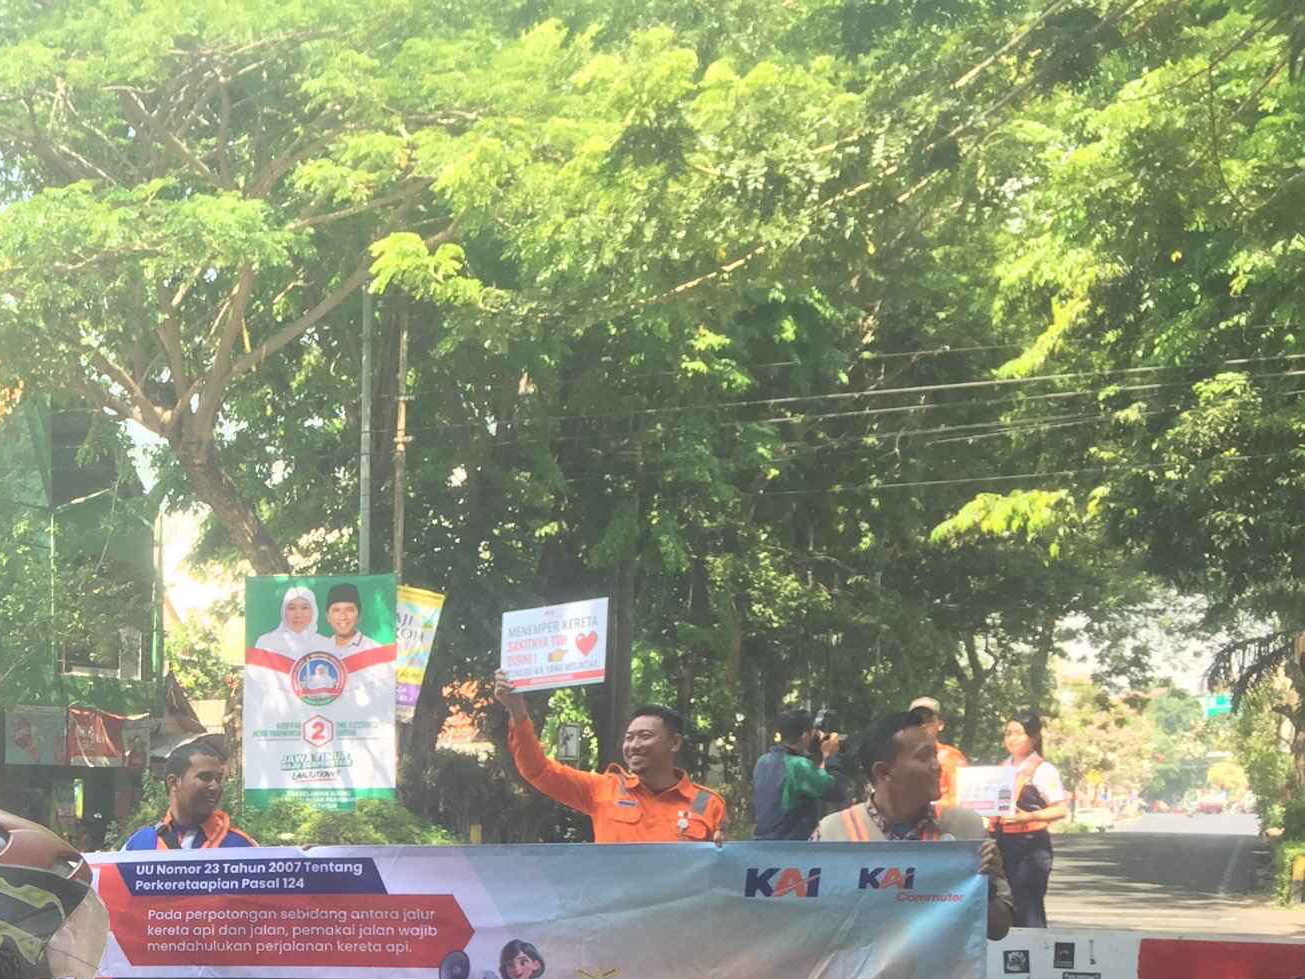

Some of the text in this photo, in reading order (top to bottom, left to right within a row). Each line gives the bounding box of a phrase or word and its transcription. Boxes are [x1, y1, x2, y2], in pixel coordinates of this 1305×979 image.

[310, 721, 326, 740] 2
[135, 861, 363, 876] UU Nomor 23 Tahun 2007 Tentang
[135, 877, 305, 893] Perkeretaapian Pasal 124
[147, 908, 435, 923] Pada perpotongan sebidang antara jalur
[147, 924, 439, 939] kereta api dan jalan, pemakai jalan wajib
[147, 940, 413, 955] mendahulukan perjalanan kereta api.
